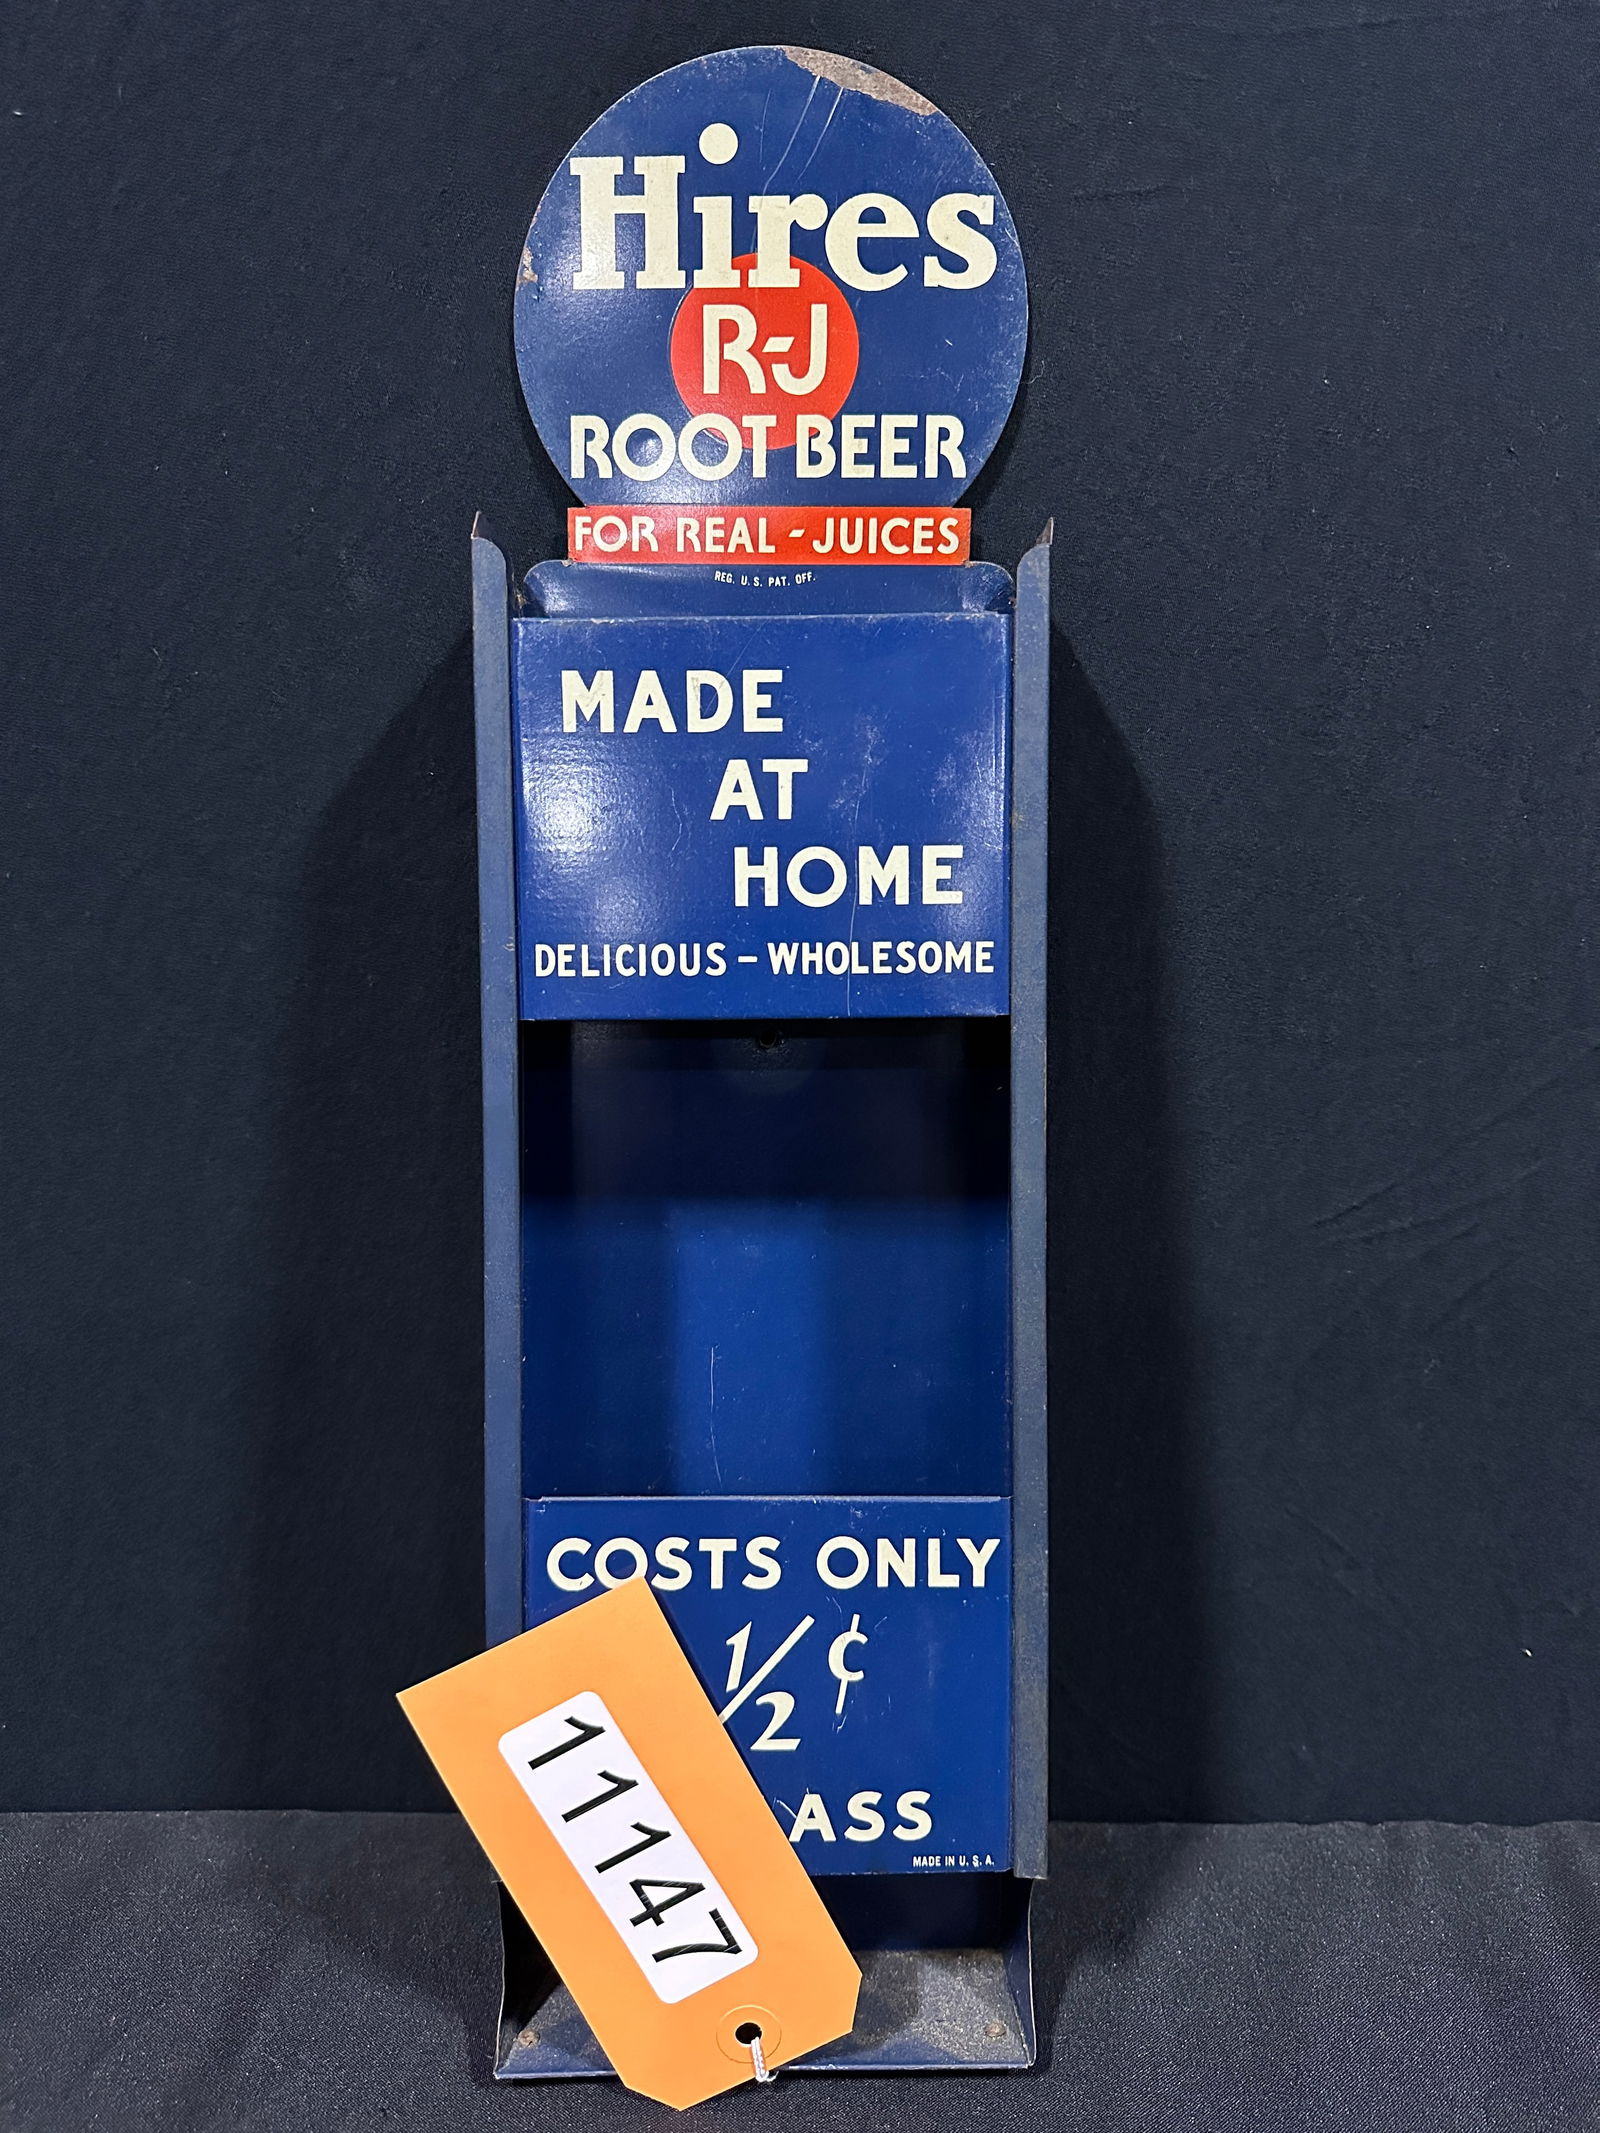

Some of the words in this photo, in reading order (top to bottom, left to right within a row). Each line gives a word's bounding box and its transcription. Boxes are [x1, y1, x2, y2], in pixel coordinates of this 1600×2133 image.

[569, 123, 998, 291] Hires
[702, 304, 828, 396] R-J
[570, 413, 777, 482] ROOT
[796, 414, 967, 479] BEER
[575, 514, 659, 553] FOR
[676, 515, 776, 554] REAL
[812, 516, 960, 554] JUICES
[714, 570, 735, 585] REG.
[768, 575, 791, 587] PAT.
[795, 571, 816, 585] OFF.
[562, 669, 784, 734] MADE
[710, 758, 808, 820] AT
[733, 844, 964, 907] HOME
[534, 942, 727, 978] DELICIOUS
[768, 940, 995, 975] WHOLESOME
[546, 1536, 781, 1592] COSTS
[816, 1536, 1000, 1589] ONLY
[527, 1715, 743, 1963] 11147
[789, 1790, 932, 1843] ASS
[912, 1855, 942, 1868] MADE
[944, 1855, 956, 1867] IN
